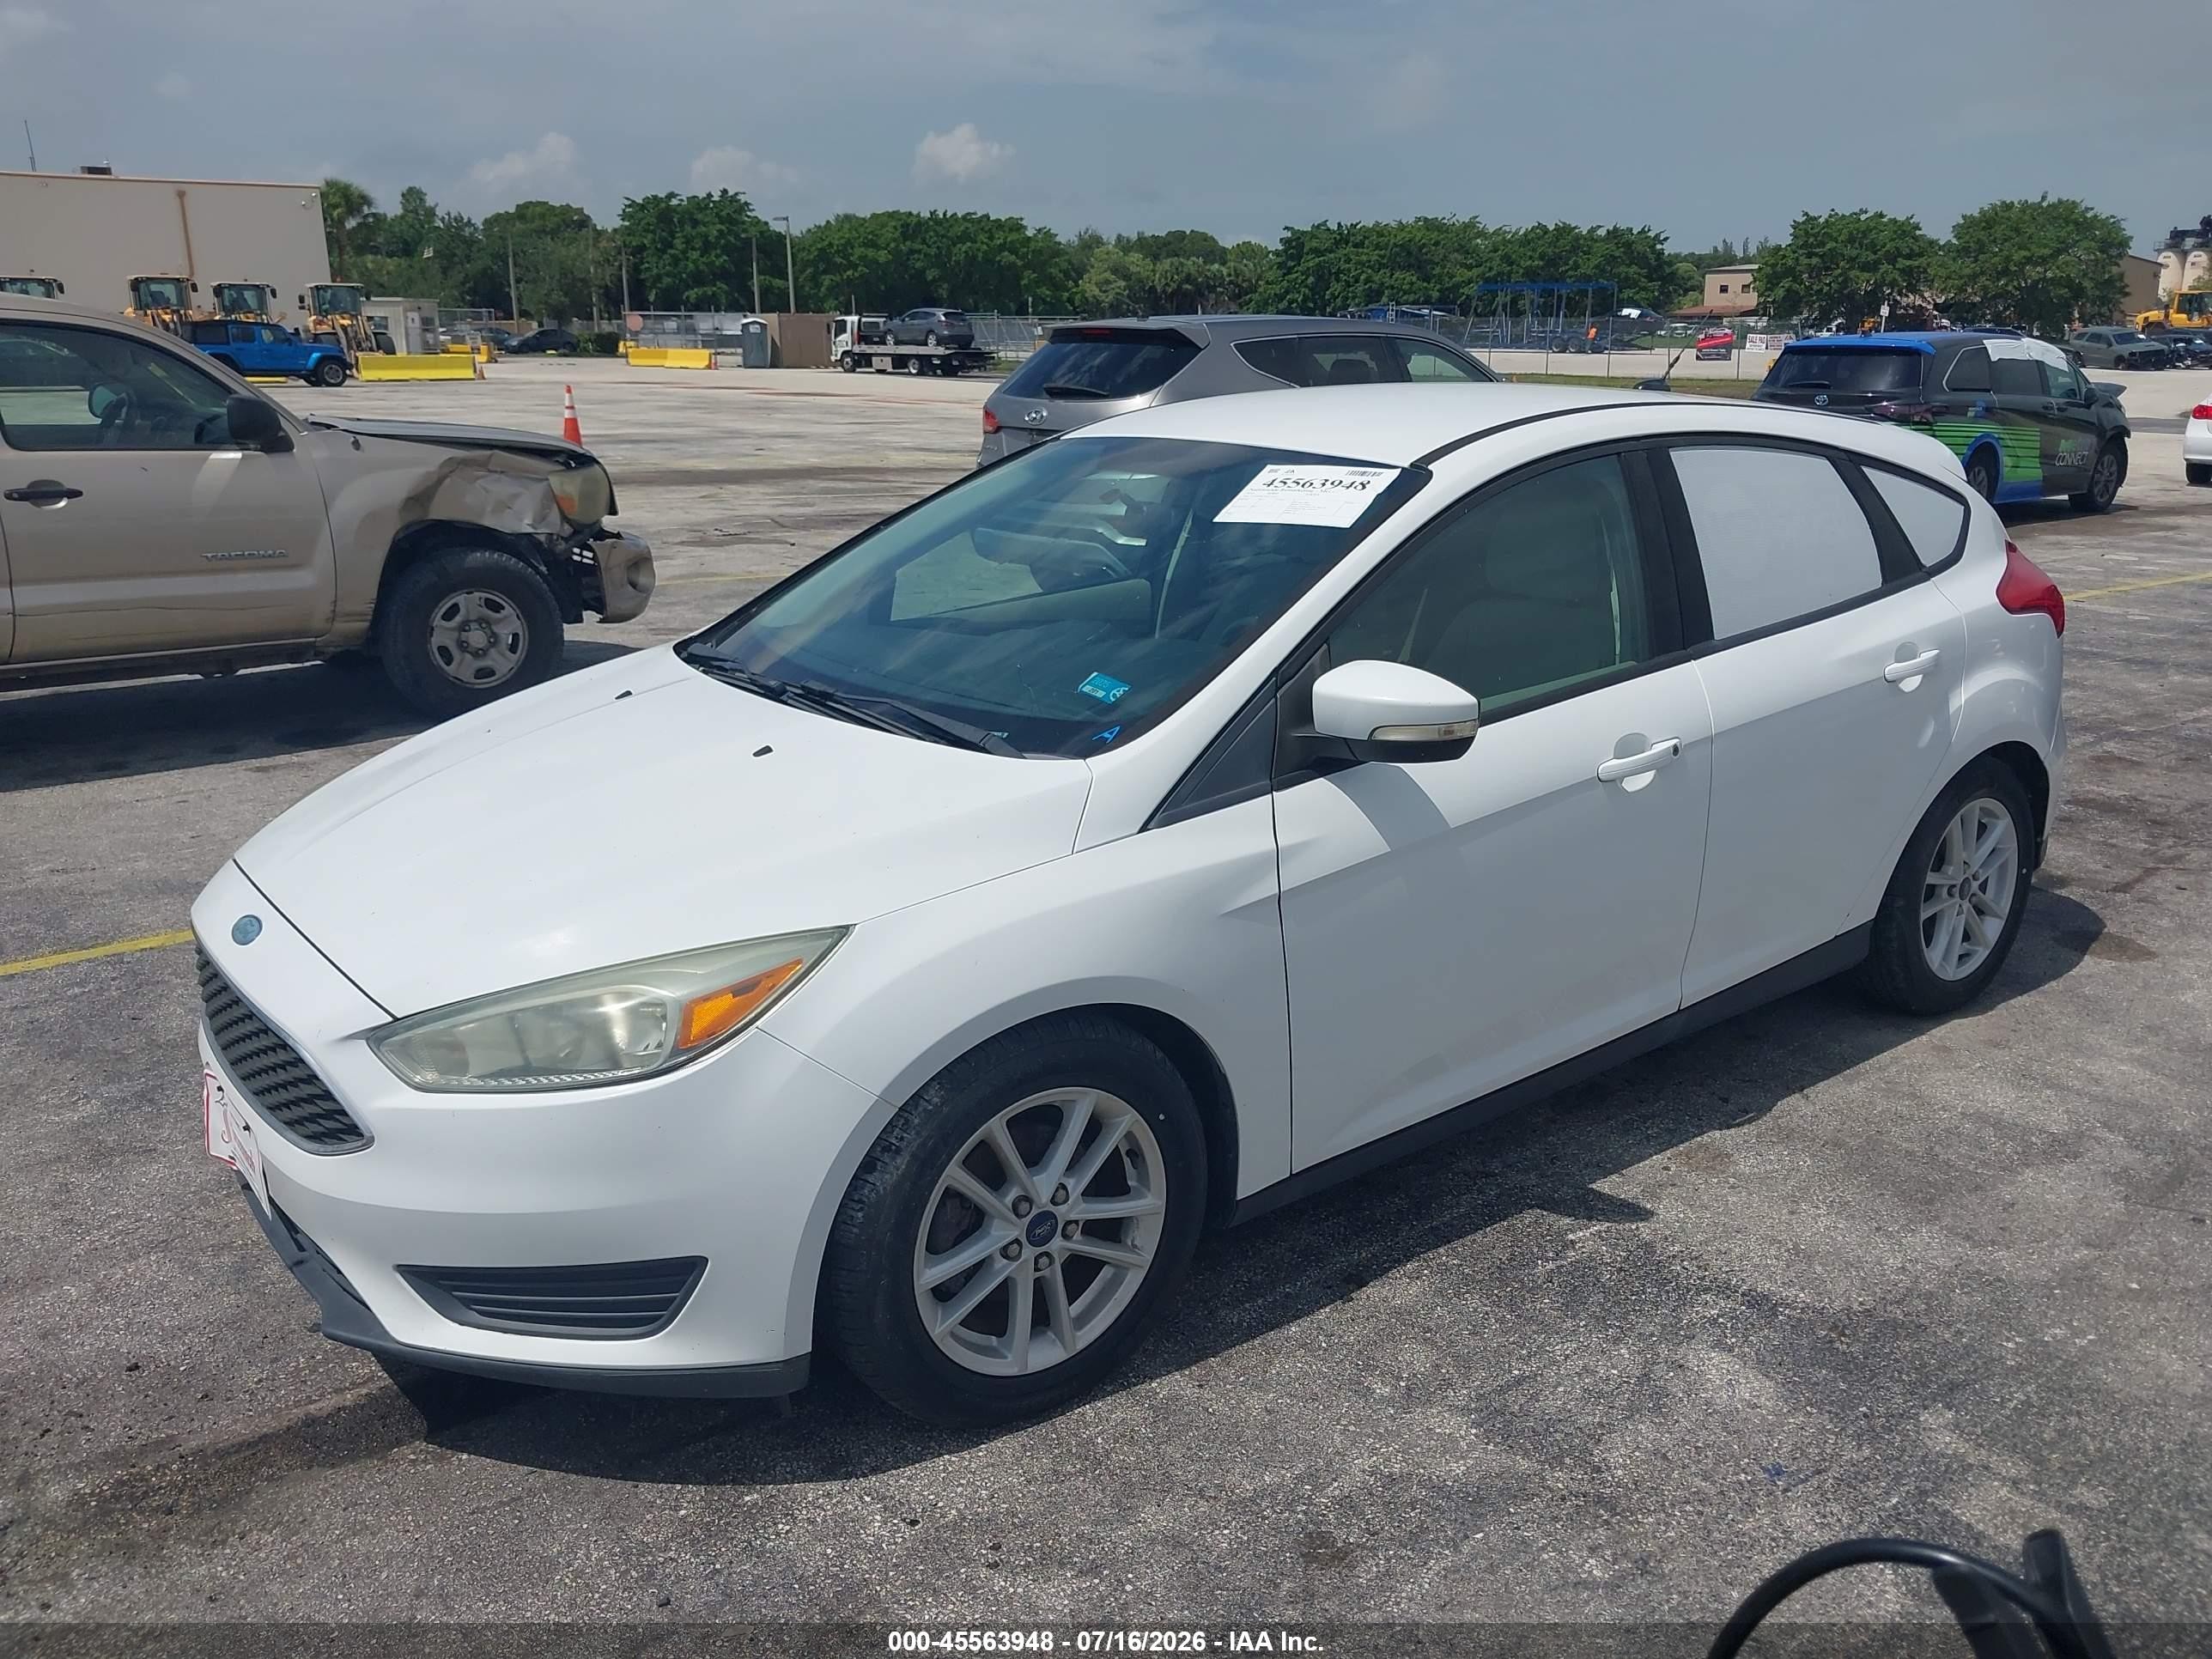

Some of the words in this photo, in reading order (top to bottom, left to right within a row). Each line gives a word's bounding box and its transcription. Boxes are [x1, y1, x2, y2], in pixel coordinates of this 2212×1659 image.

[2055, 451, 2089, 466] CONNECT
[1262, 477, 1371, 491] 45563948
[200, 549, 289, 562] TACOMA
